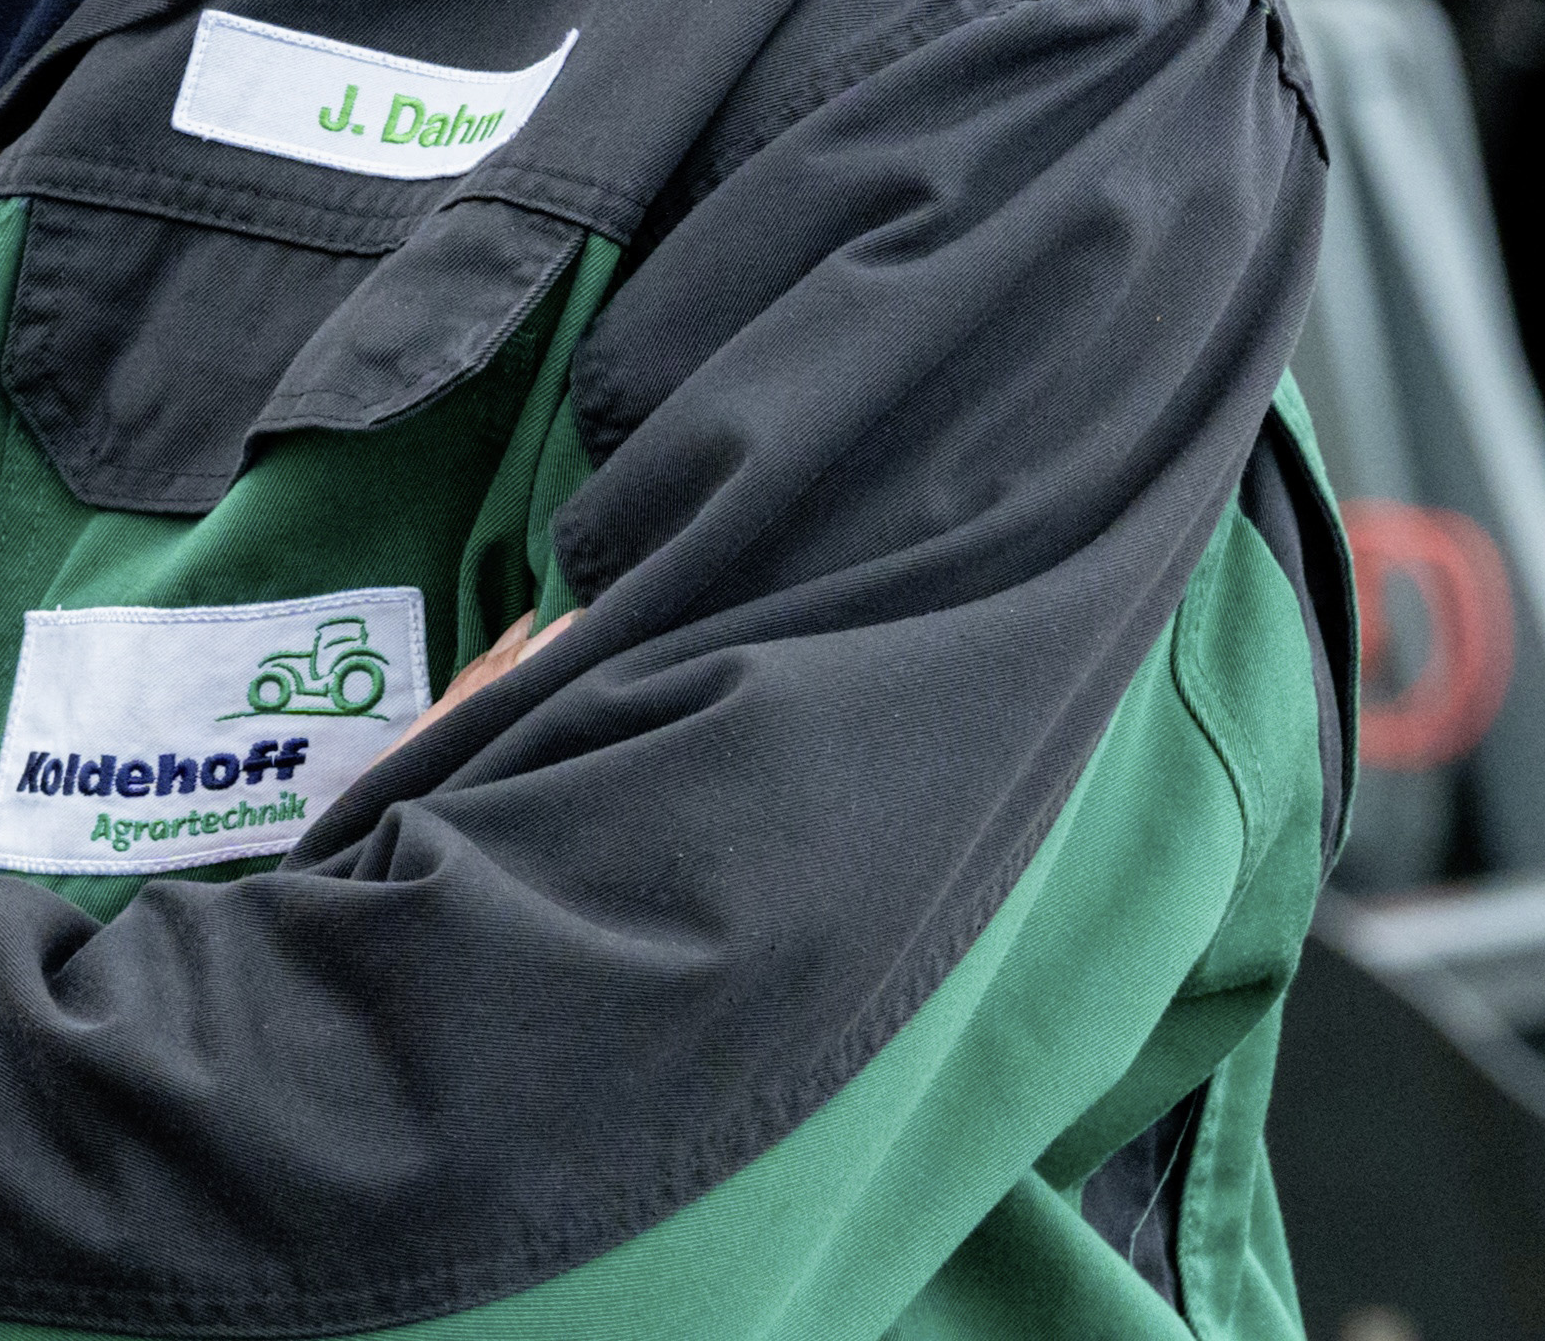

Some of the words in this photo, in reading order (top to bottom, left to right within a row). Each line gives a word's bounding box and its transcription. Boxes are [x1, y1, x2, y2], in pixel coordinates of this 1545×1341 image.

[318, 83, 365, 136] J.
[15, 737, 310, 799] Koldehoff
[89, 790, 309, 853] Agrartechnik
